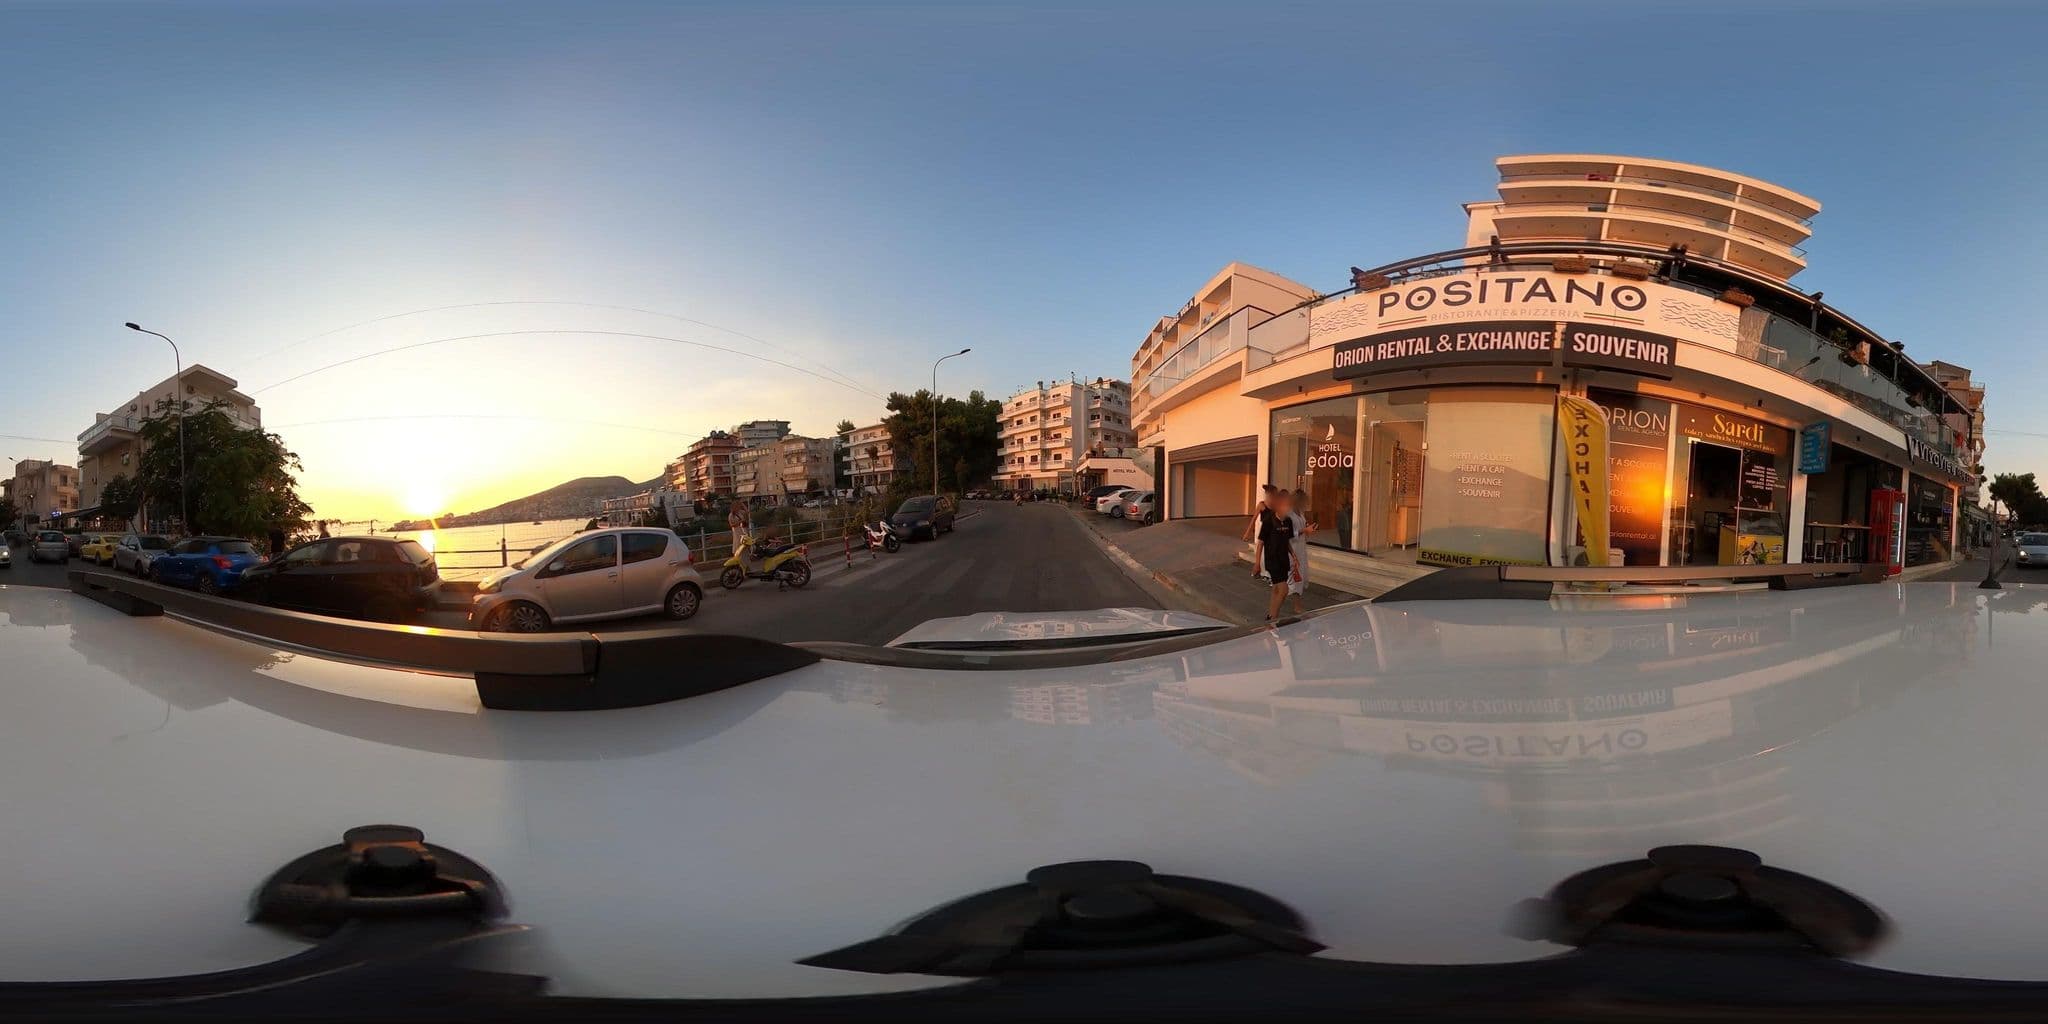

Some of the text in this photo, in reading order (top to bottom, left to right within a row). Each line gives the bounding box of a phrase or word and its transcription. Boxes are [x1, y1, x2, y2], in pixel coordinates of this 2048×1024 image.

[1378, 277, 1647, 317] POSITANO
[1335, 331, 1551, 368] ORION RENTAL & EXCHANGE
[1573, 332, 1669, 365] SOUVENIR
[1599, 405, 1667, 432] ORION
[1713, 413, 1764, 443] Sardi
[1319, 443, 1341, 452] HOTEL
[1308, 452, 1354, 468] edola
[1461, 464, 1505, 474] RENT A CAR
[1461, 476, 1503, 487] EXCHANGE
[1609, 473, 1624, 481] ENT
[1463, 488, 1501, 498] SOUVENIR
[1421, 551, 1473, 566] EXCHANGE
